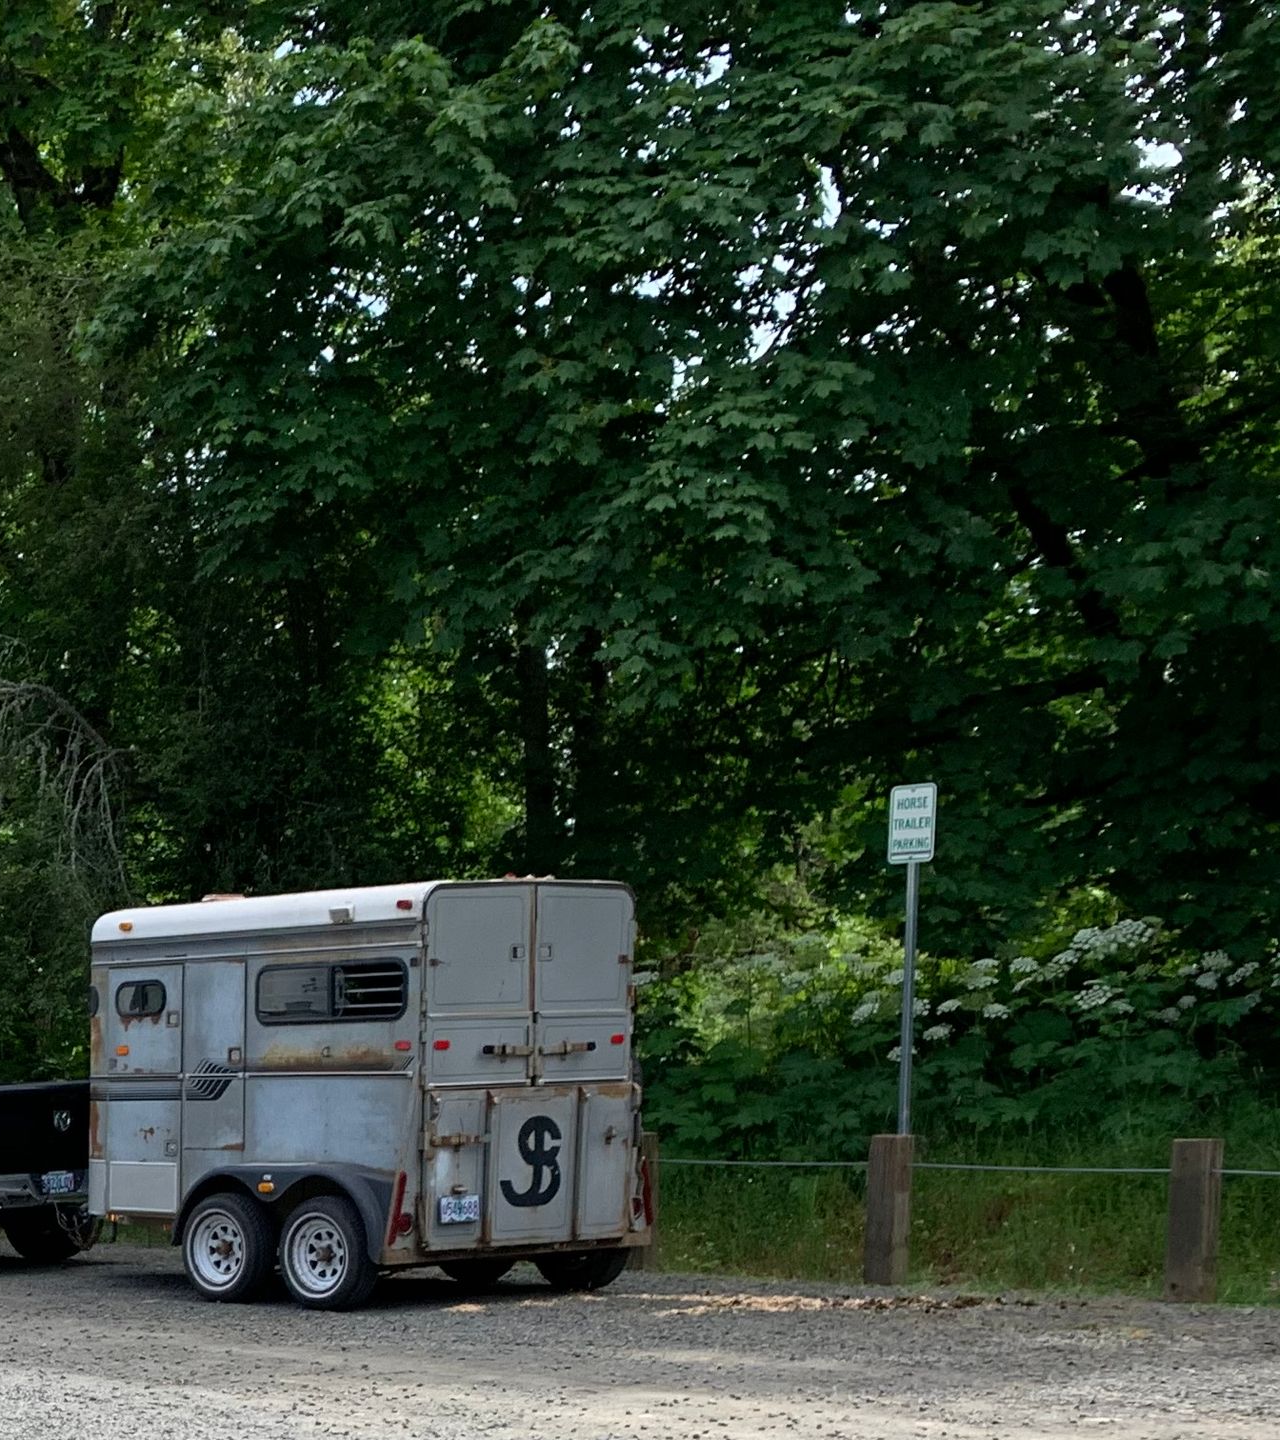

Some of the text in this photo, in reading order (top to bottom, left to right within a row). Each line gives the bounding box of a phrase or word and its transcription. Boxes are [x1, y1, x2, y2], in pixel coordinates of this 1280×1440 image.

[896, 796, 928, 810] HORSE
[894, 816, 931, 830] TRAILER
[893, 837, 930, 850] PARKING
